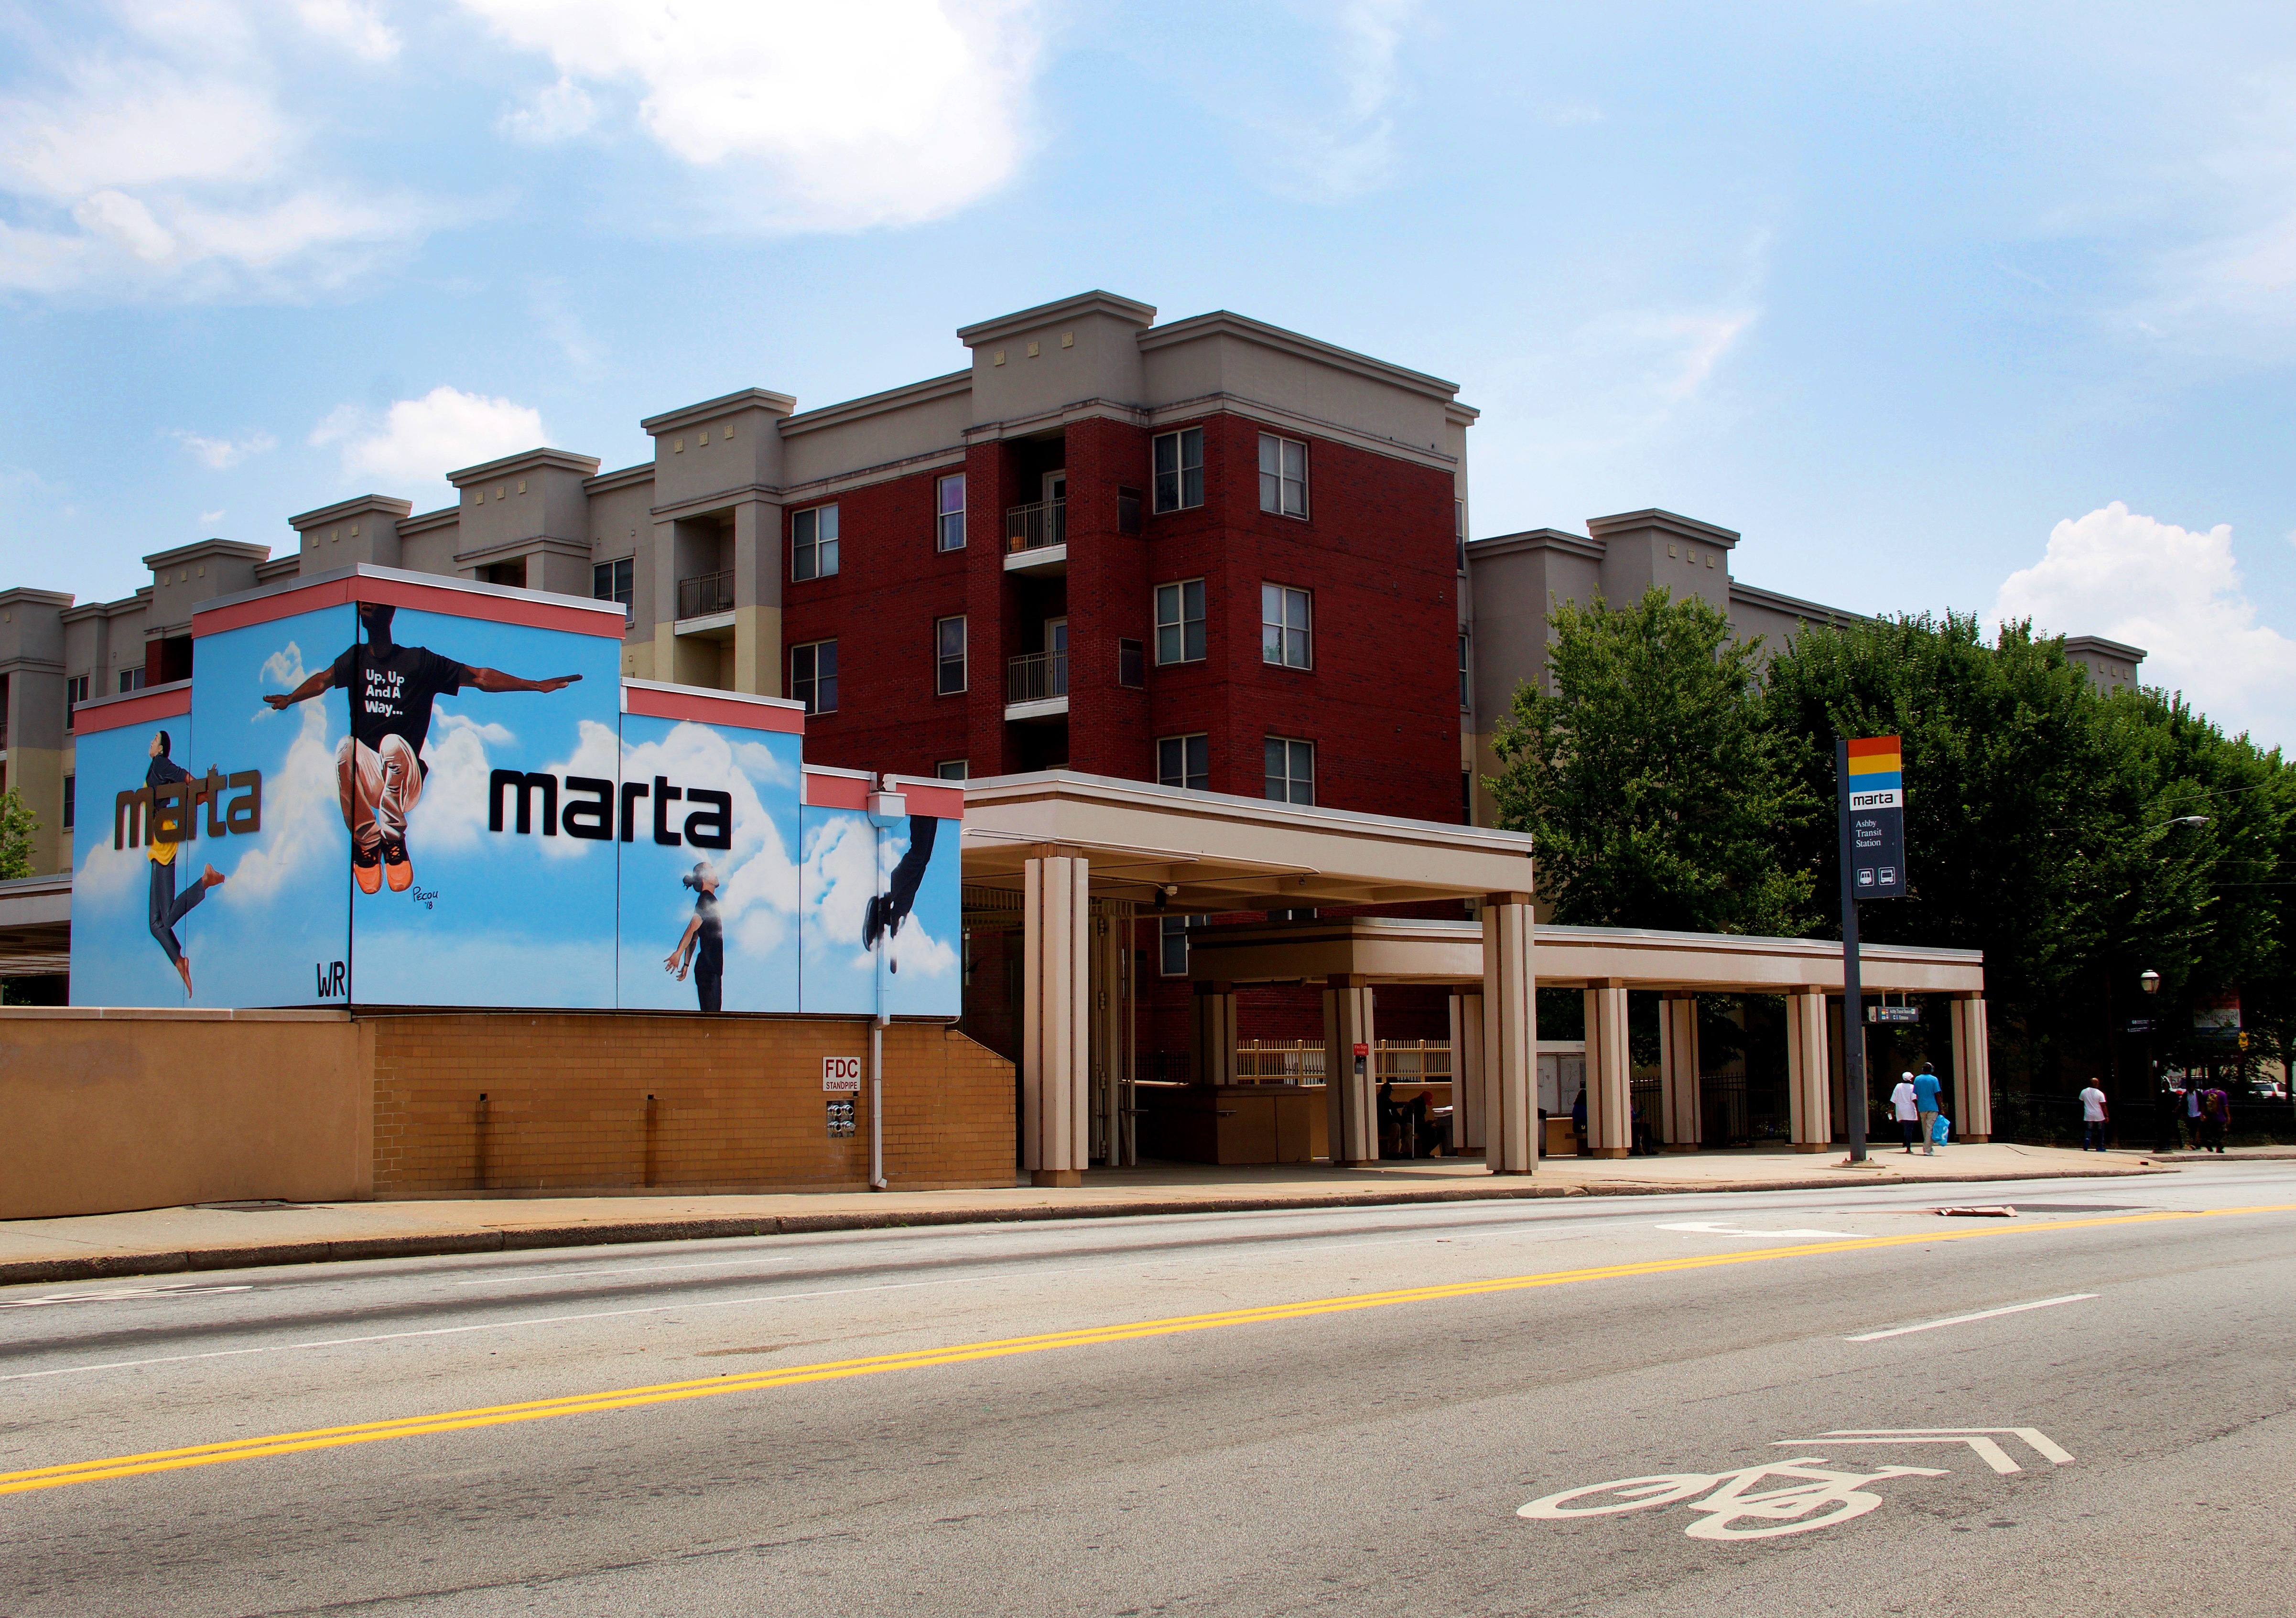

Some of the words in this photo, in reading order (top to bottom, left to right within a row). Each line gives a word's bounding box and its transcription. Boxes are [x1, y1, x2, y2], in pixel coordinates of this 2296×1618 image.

[366, 669, 386, 685] Up,
[388, 671, 404, 686] Up
[366, 685, 390, 698] And
[392, 687, 401, 698] A
[365, 700, 403, 717] Way...
[1853, 793, 1893, 806] marta
[114, 767, 261, 850] marta
[489, 768, 732, 850] marta
[1856, 820, 1876, 828] Ashby
[1856, 828, 1882, 837] Transit
[1856, 839, 1881, 848] Station
[316, 961, 346, 997] WR
[826, 1059, 858, 1078] FDC
[826, 1081, 857, 1089] STANDPIPE
